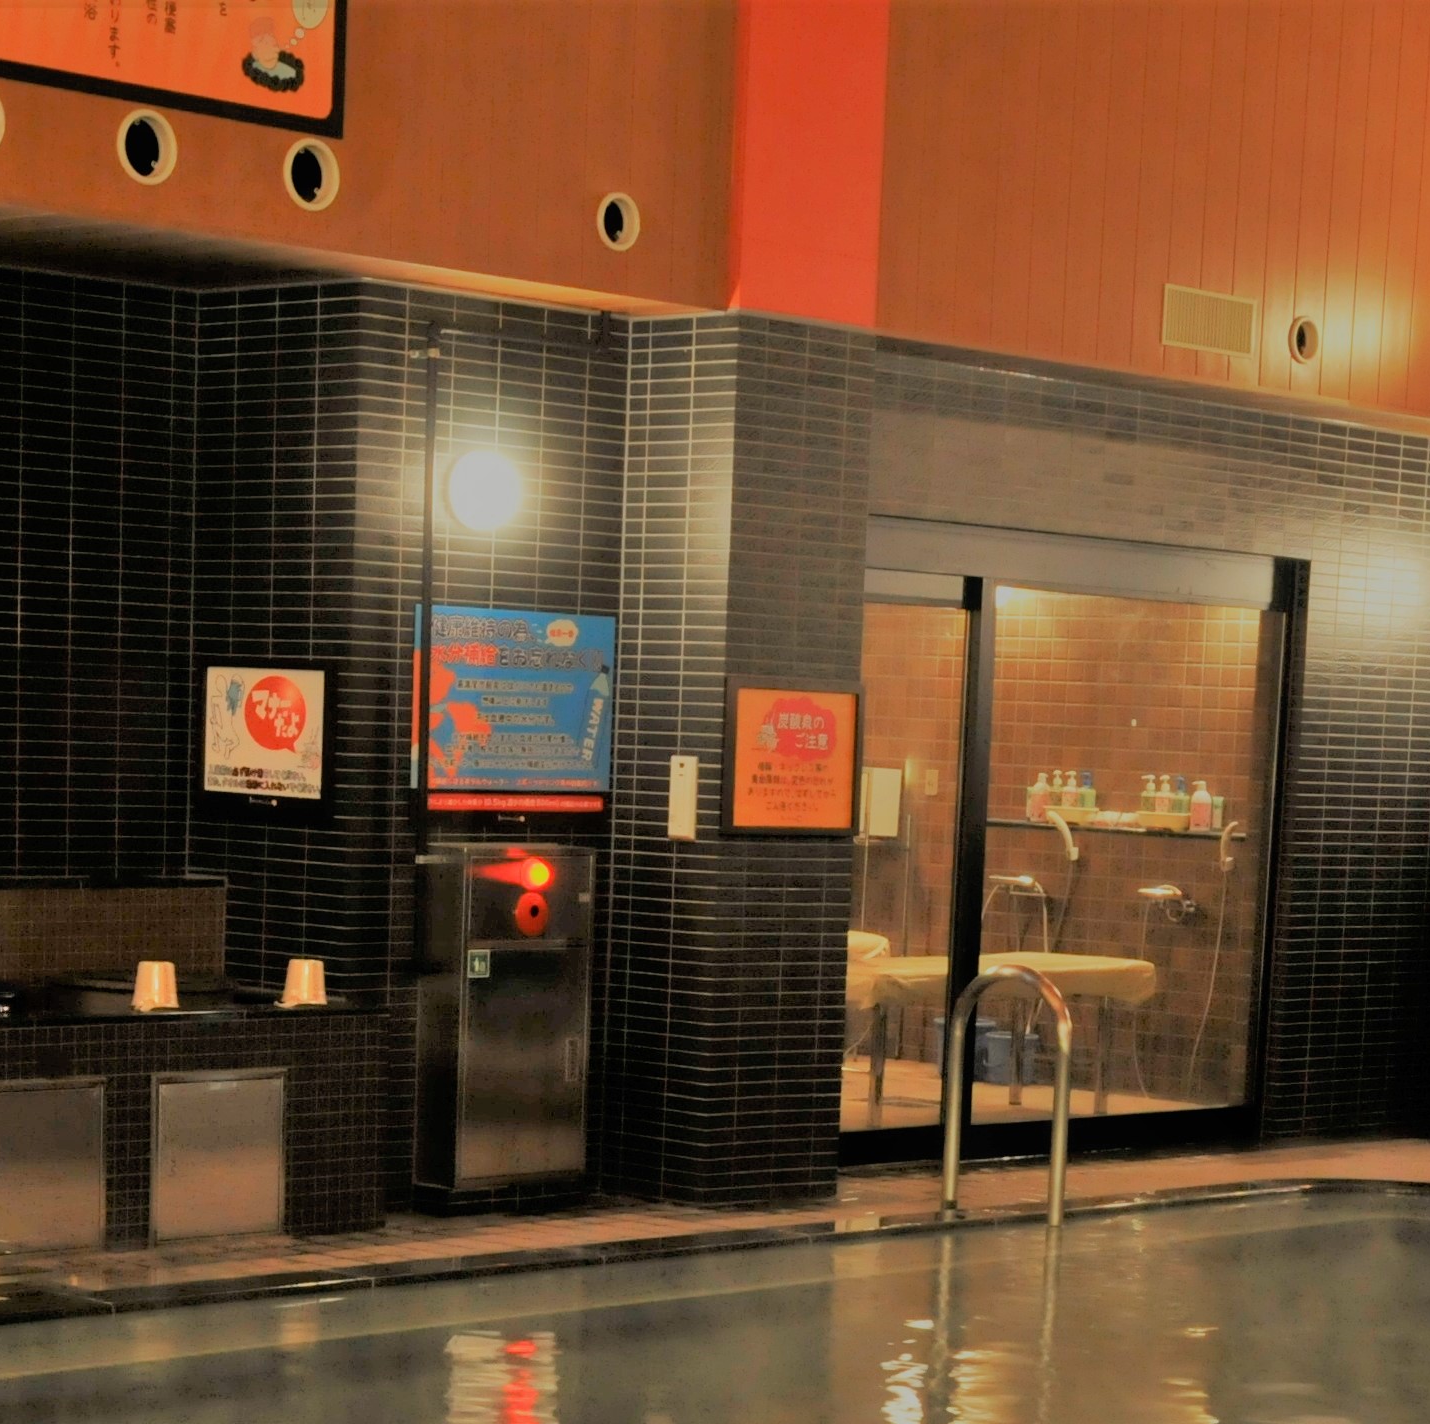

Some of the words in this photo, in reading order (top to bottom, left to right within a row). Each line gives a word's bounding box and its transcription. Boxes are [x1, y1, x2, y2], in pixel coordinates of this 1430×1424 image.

[252, 690, 292, 720] マナー
[274, 711, 299, 738] だよ
[583, 697, 605, 762] WATER
[777, 712, 825, 730] 炭酸泉の
[795, 733, 828, 750] ご注意
